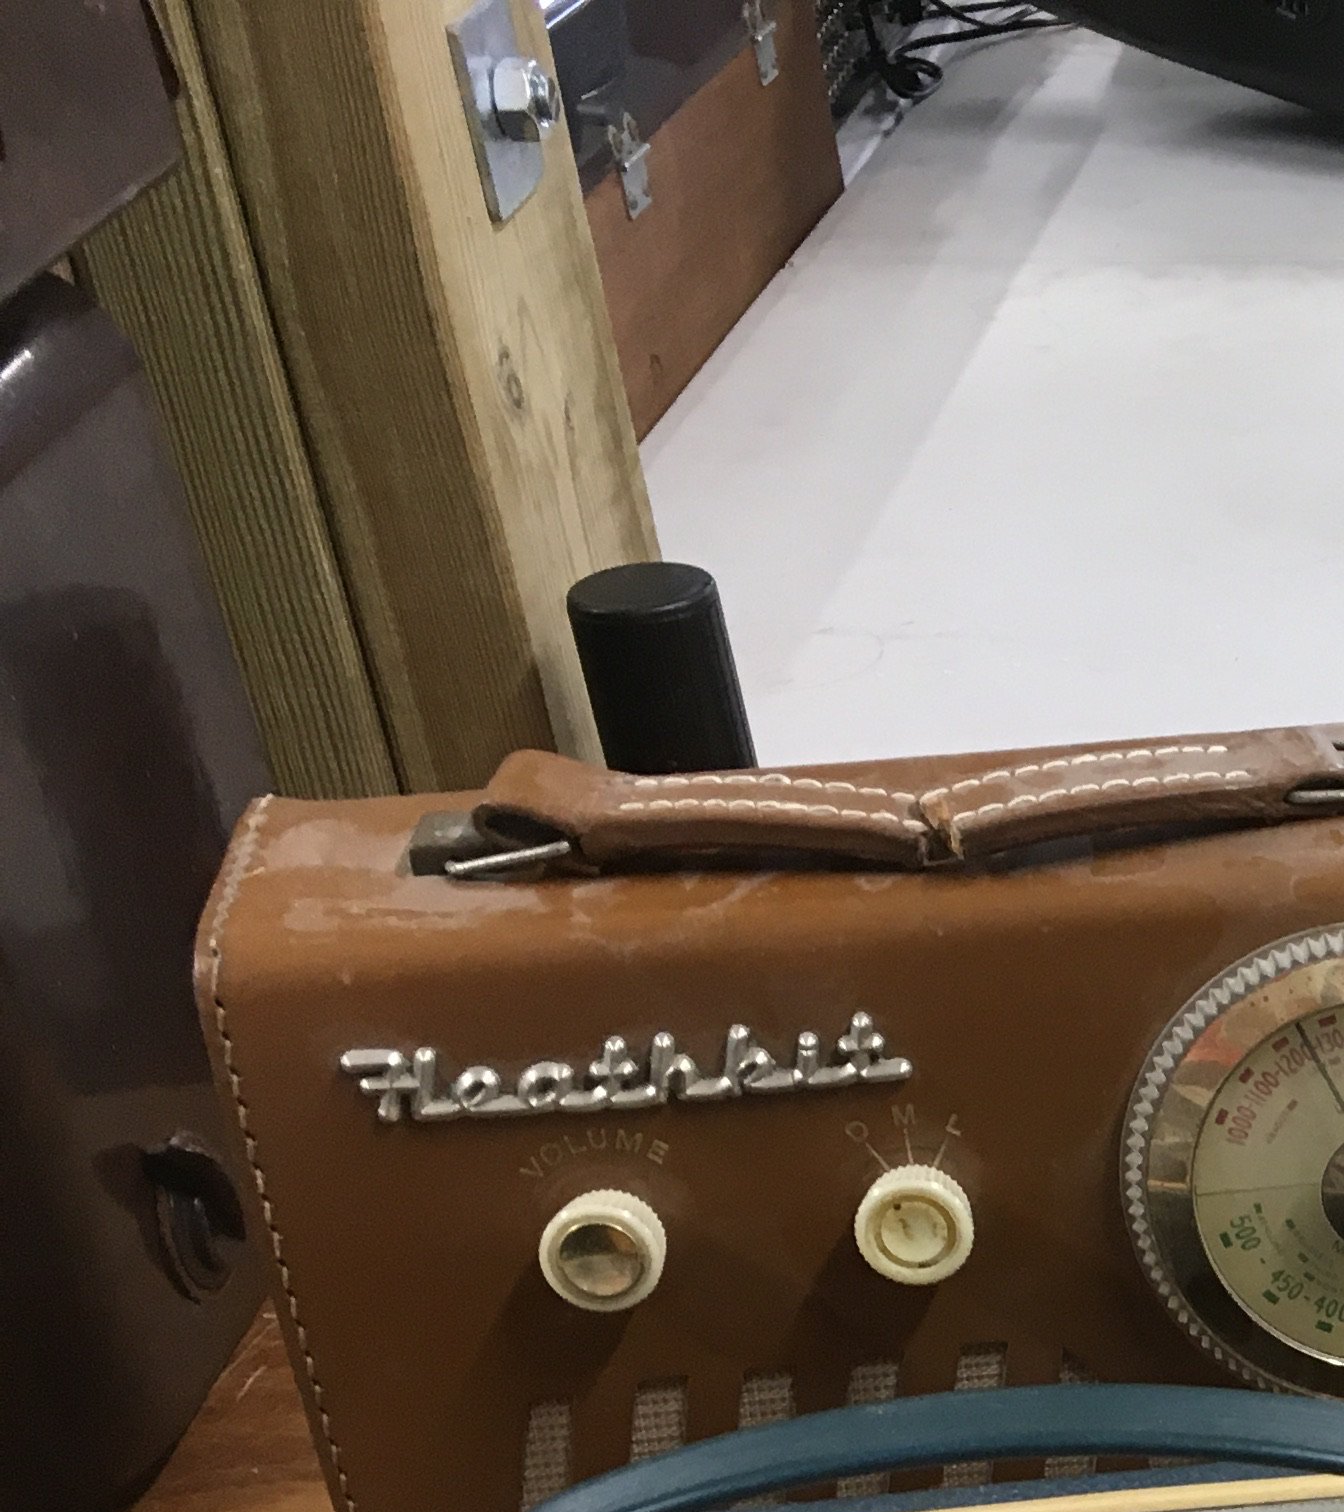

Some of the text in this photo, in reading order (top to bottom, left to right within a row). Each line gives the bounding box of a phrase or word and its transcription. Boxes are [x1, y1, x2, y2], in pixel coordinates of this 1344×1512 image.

[339, 1011, 912, 1122] Heathkit
[519, 1129, 670, 1180] VOLUME
[1230, 1214, 1261, 1251] 500
[1271, 1269, 1304, 1300] 450
